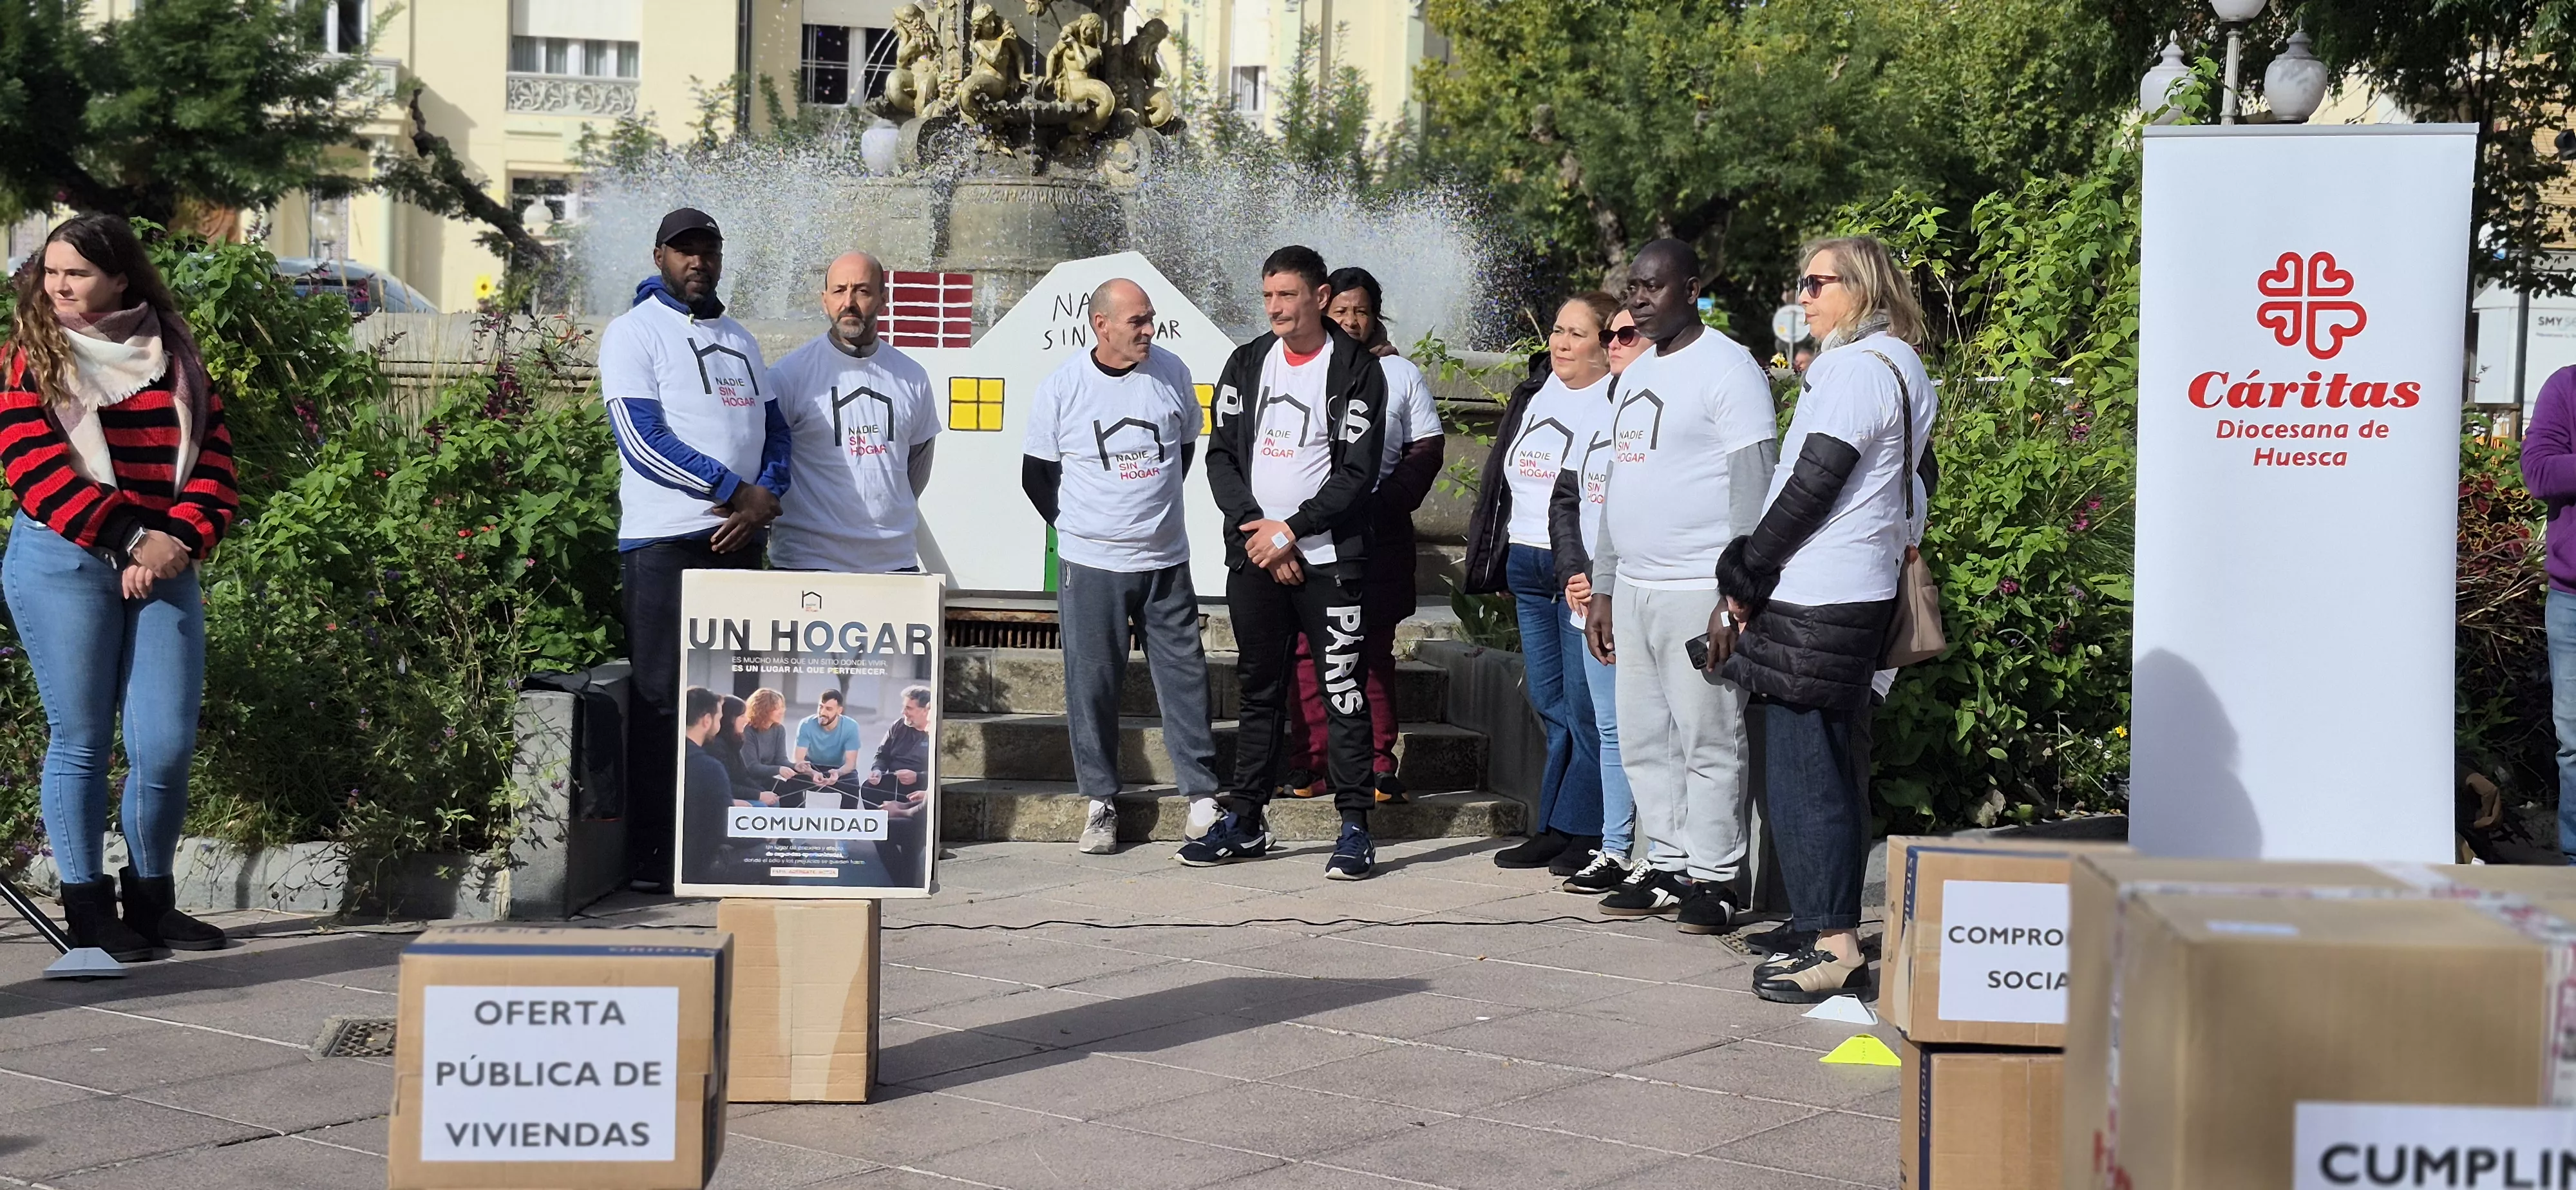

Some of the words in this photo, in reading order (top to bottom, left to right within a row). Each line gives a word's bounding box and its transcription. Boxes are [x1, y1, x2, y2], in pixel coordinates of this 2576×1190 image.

[1042, 324, 1086, 350] SIN
[715, 377, 745, 387] NADIE
[719, 386, 736, 397] SIN
[2188, 369, 2421, 409] Cáritas
[722, 397, 756, 407] HOGAR
[1217, 384, 1244, 428] P
[848, 424, 879, 435] NADIE
[1619, 430, 1643, 440] NADIE
[2216, 420, 2349, 439] Diocesana
[2358, 419, 2389, 439] de
[849, 435, 866, 446] SIN
[1264, 437, 1276, 446] IN
[1618, 441, 1630, 451] SIN
[851, 444, 887, 457] HOGAR
[1115, 450, 1150, 463] NADIE
[1520, 450, 1551, 460] NADIE
[2253, 447, 2348, 466] Huesca
[1119, 462, 1138, 471] SIN
[1519, 458, 1536, 468] SIN
[1121, 467, 1160, 480] HOGAR
[1520, 468, 1556, 480] HOGAR
[1587, 472, 1606, 482] NAD
[1587, 482, 1601, 493] SIN
[1587, 492, 1604, 504] HOG
[689, 617, 750, 650] UN
[772, 619, 933, 656] HOGAR
[773, 656, 789, 665] MÁS
[1325, 605, 1365, 715] PARIS
[735, 815, 879, 833] COMUNIDAD
[1904, 857, 1913, 927] RIFOLS
[1948, 925, 2066, 946] COMPRO
[1987, 970, 2069, 990] SOCIA
[475, 1000, 625, 1026] OFERTA
[437, 1055, 600, 1087] PÚBLICA
[614, 1061, 662, 1086] DE
[445, 1122, 650, 1148] VIVIENDAS
